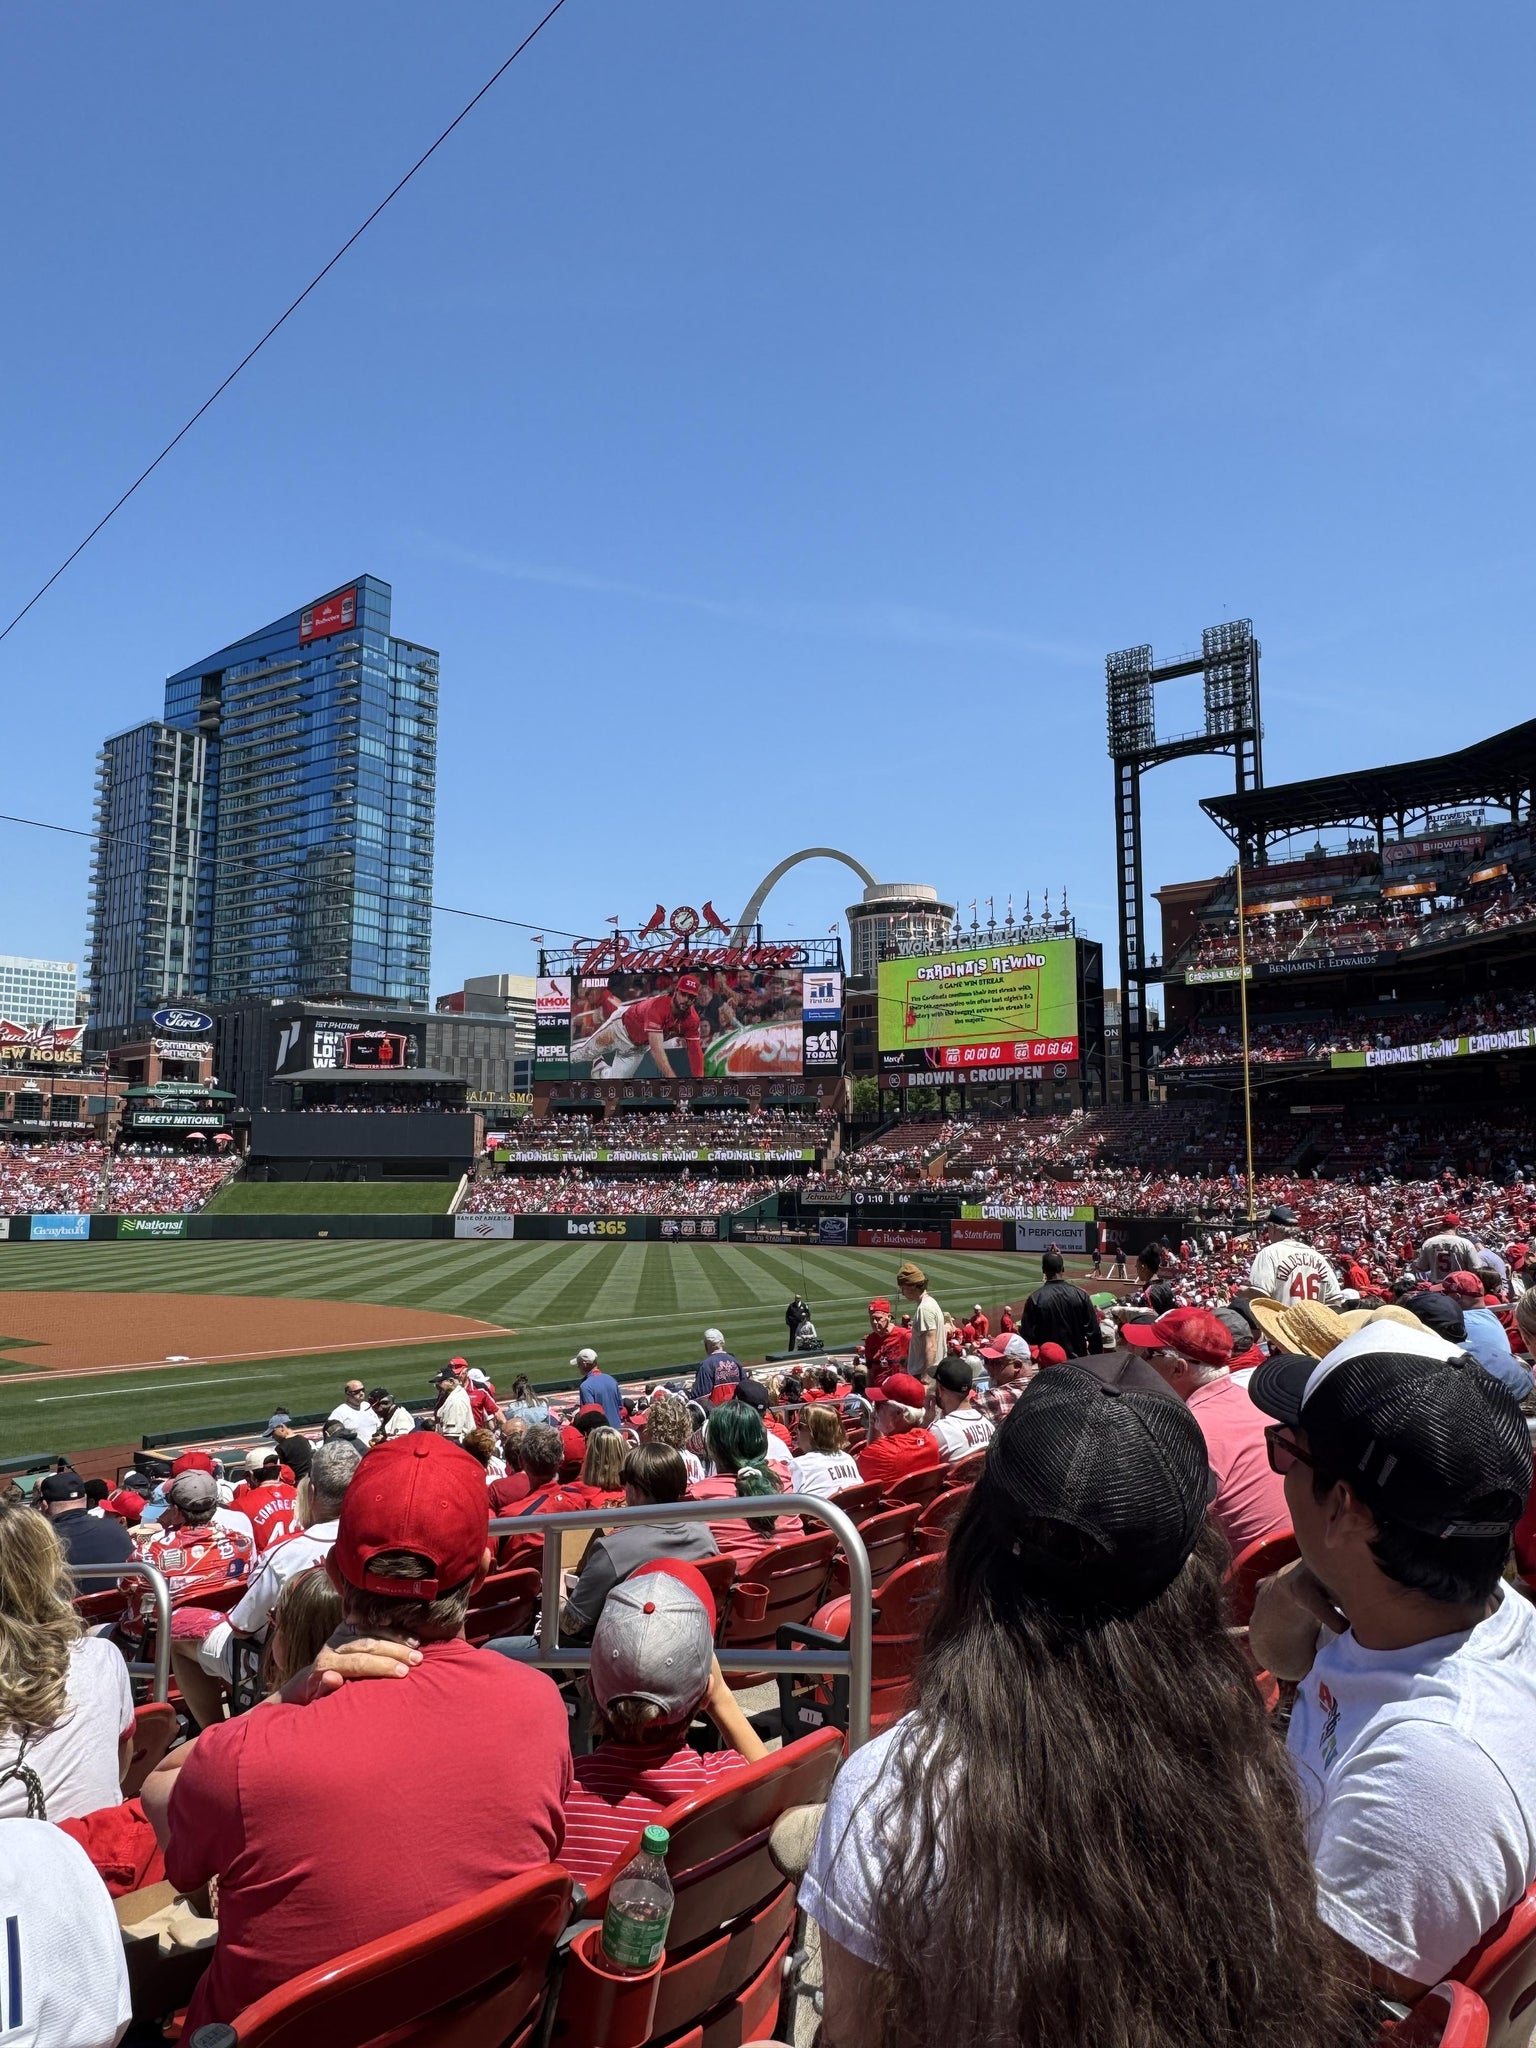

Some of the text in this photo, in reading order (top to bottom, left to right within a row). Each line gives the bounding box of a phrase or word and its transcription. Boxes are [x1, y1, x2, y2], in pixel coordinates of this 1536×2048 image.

[898, 924, 1056, 956] WORLD CHAMPIONS
[573, 936, 803, 976] Budweiser
[917, 953, 1046, 980] CARDINALS REWIND
[1269, 962, 1316, 974] BENJAMIN
[1328, 957, 1377, 968] EDWARDS
[581, 978, 609, 988] FRIDAY
[944, 981, 963, 989] GAME
[537, 997, 570, 1007] KMOX
[165, 1011, 202, 1028] Ford
[154, 1039, 211, 1053] Community
[805, 1030, 838, 1051] stl
[1468, 1029, 1529, 1054] CARDINALS
[313, 1044, 336, 1058] LO
[536, 1045, 568, 1057] REPEL
[806, 1051, 837, 1059] TODAY
[964, 1047, 1001, 1060] GO GO GO
[1034, 1041, 1073, 1055] GO GO GO
[30, 1049, 82, 1063] HOUSE
[1366, 1045, 1419, 1067] CARDINALS
[908, 1066, 1042, 1086] BROWN & CROUPPEN
[660, 1085, 672, 1098] 17
[138, 1115, 220, 1125] SAFETY NATIONAL
[509, 1150, 599, 1162] CARDINALS REWIND
[606, 1150, 699, 1162] CARDINALS REWIND
[707, 1149, 803, 1162] CARDINALS REWIND
[867, 1194, 883, 1203] 1:10
[981, 1205, 1075, 1220] CARDINALS REWIND
[135, 1219, 184, 1230] National
[567, 1219, 627, 1235] bet365
[823, 1220, 842, 1230] Ford
[883, 1233, 927, 1244] Budweiser
[1028, 1228, 1084, 1237] PERFICIENT
[1437, 1253, 1451, 1272] 5
[1290, 1272, 1319, 1300] 46
